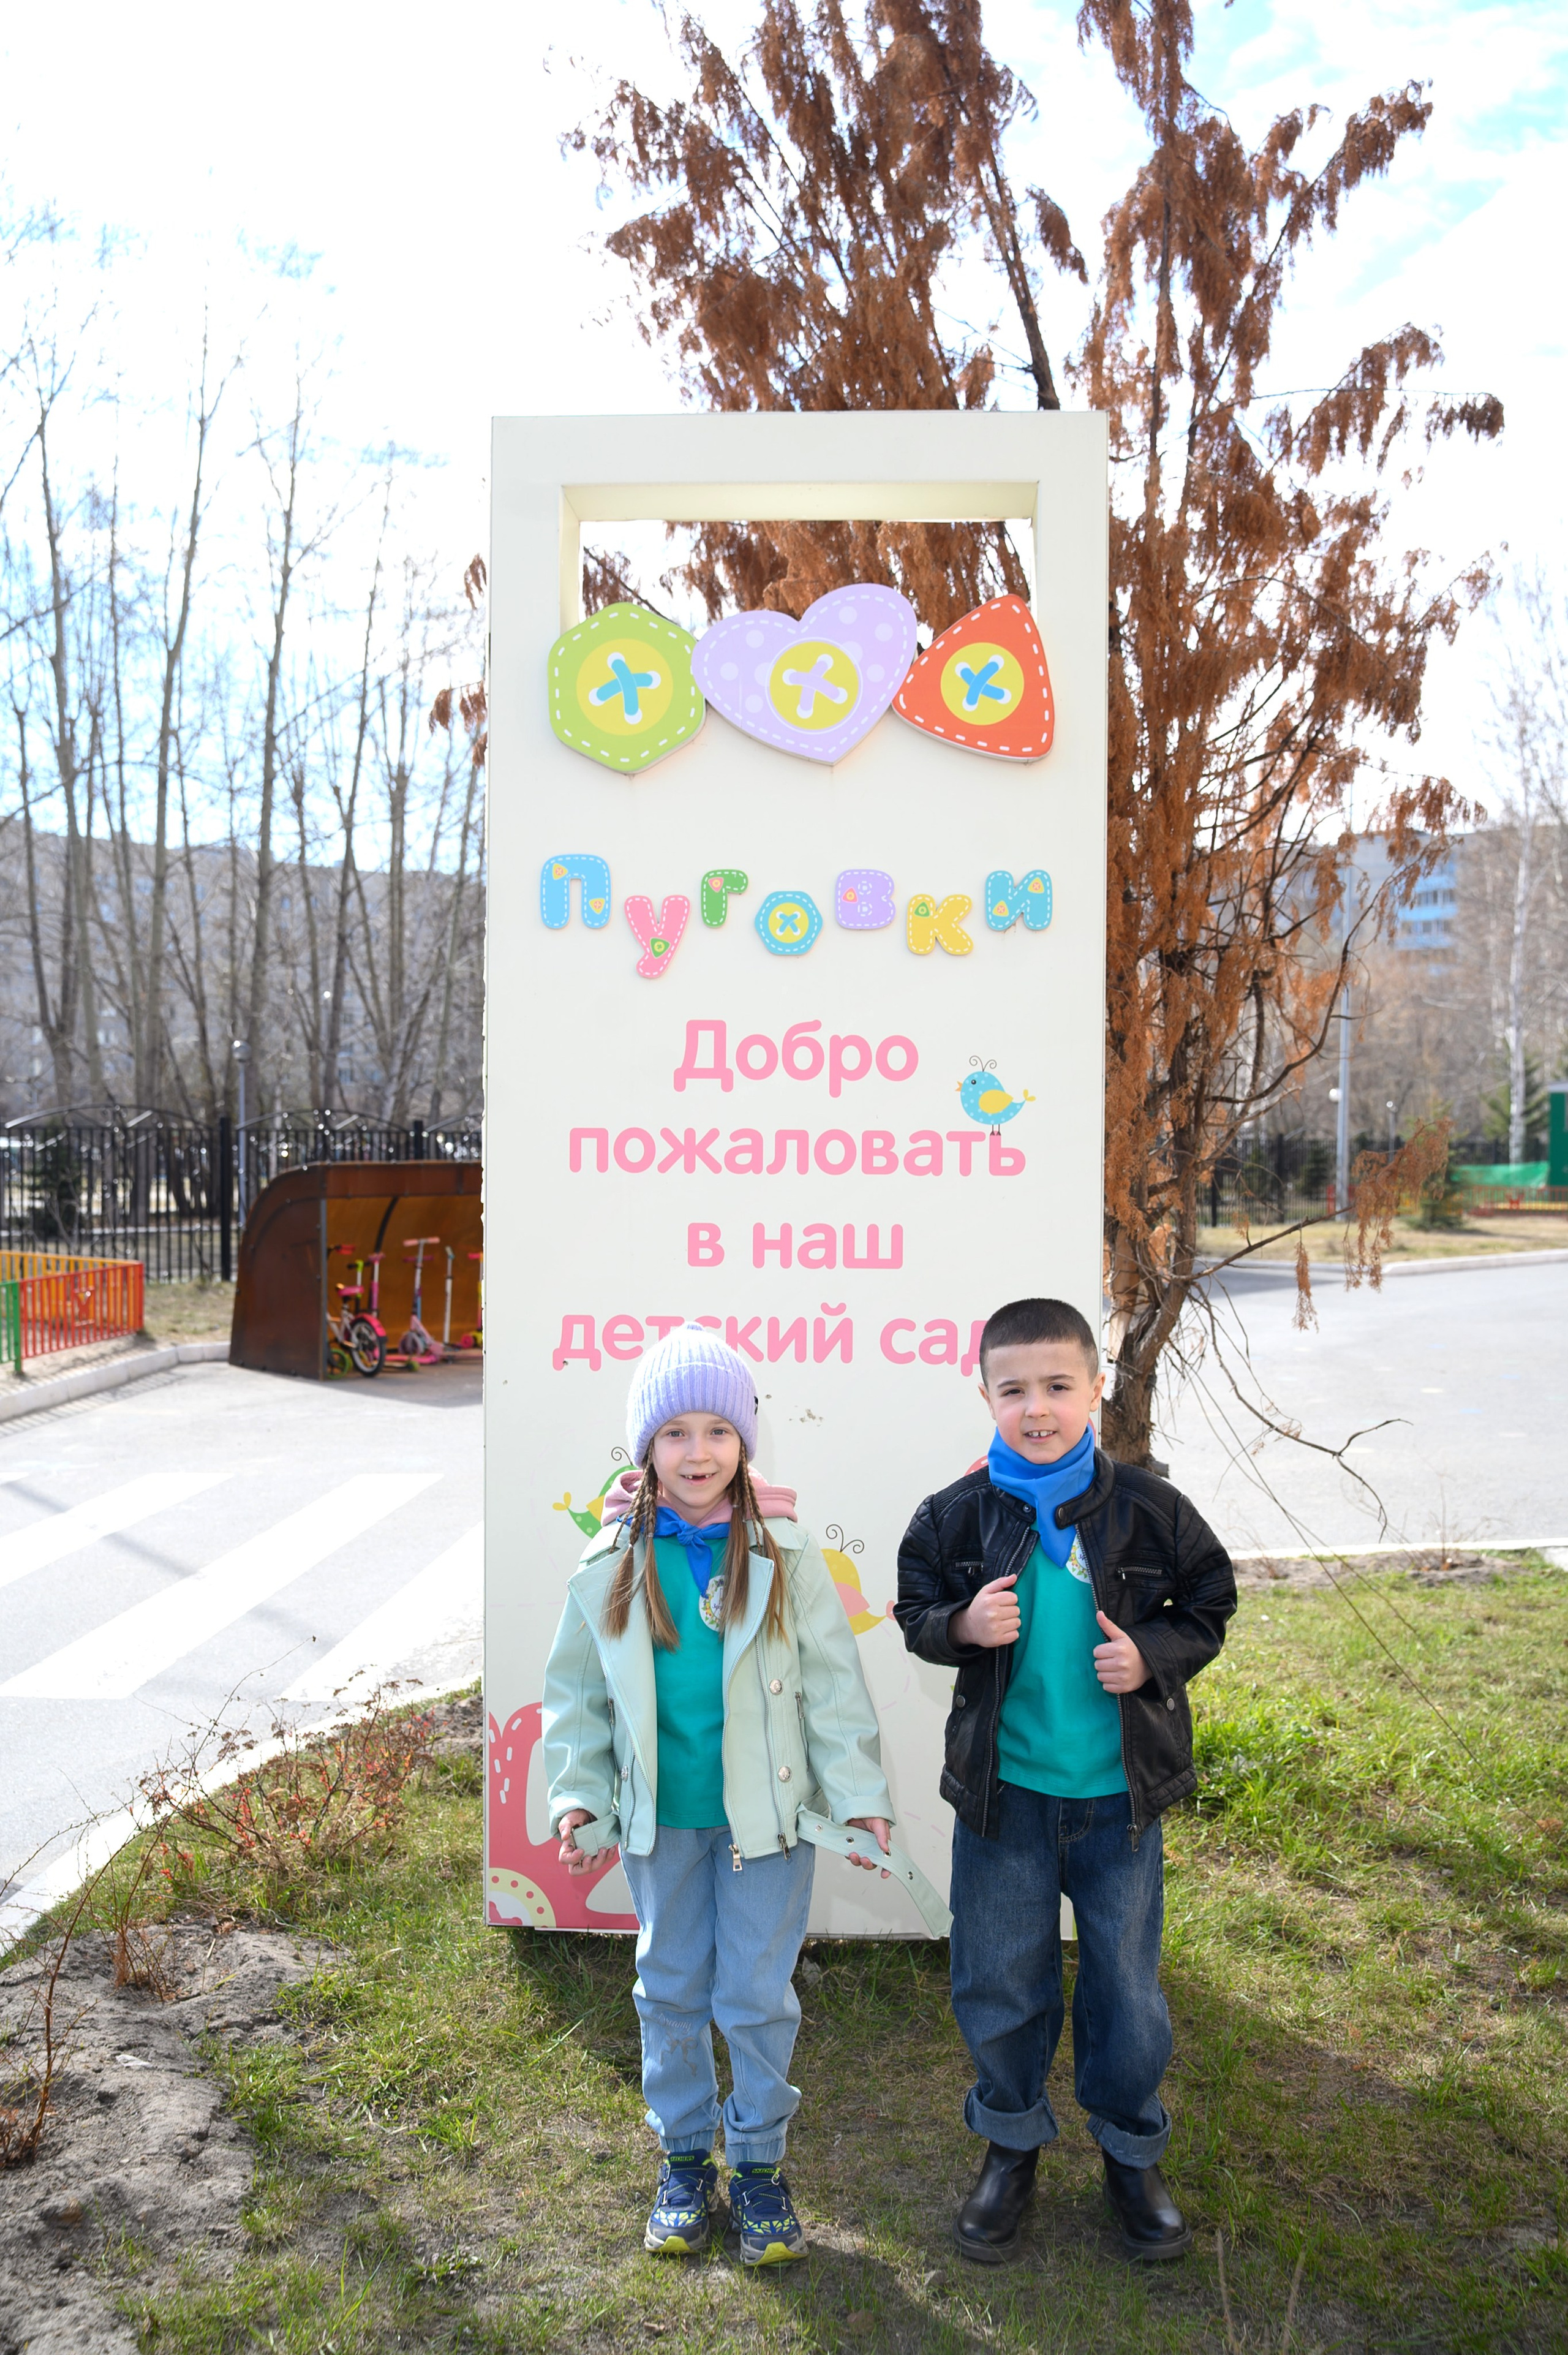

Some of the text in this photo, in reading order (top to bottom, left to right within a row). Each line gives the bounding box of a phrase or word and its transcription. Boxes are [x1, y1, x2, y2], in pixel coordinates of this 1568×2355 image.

[673, 1019, 919, 1098] Добро
[569, 1127, 1026, 1177] пожаловать
[687, 1222, 903, 1269] в наш
